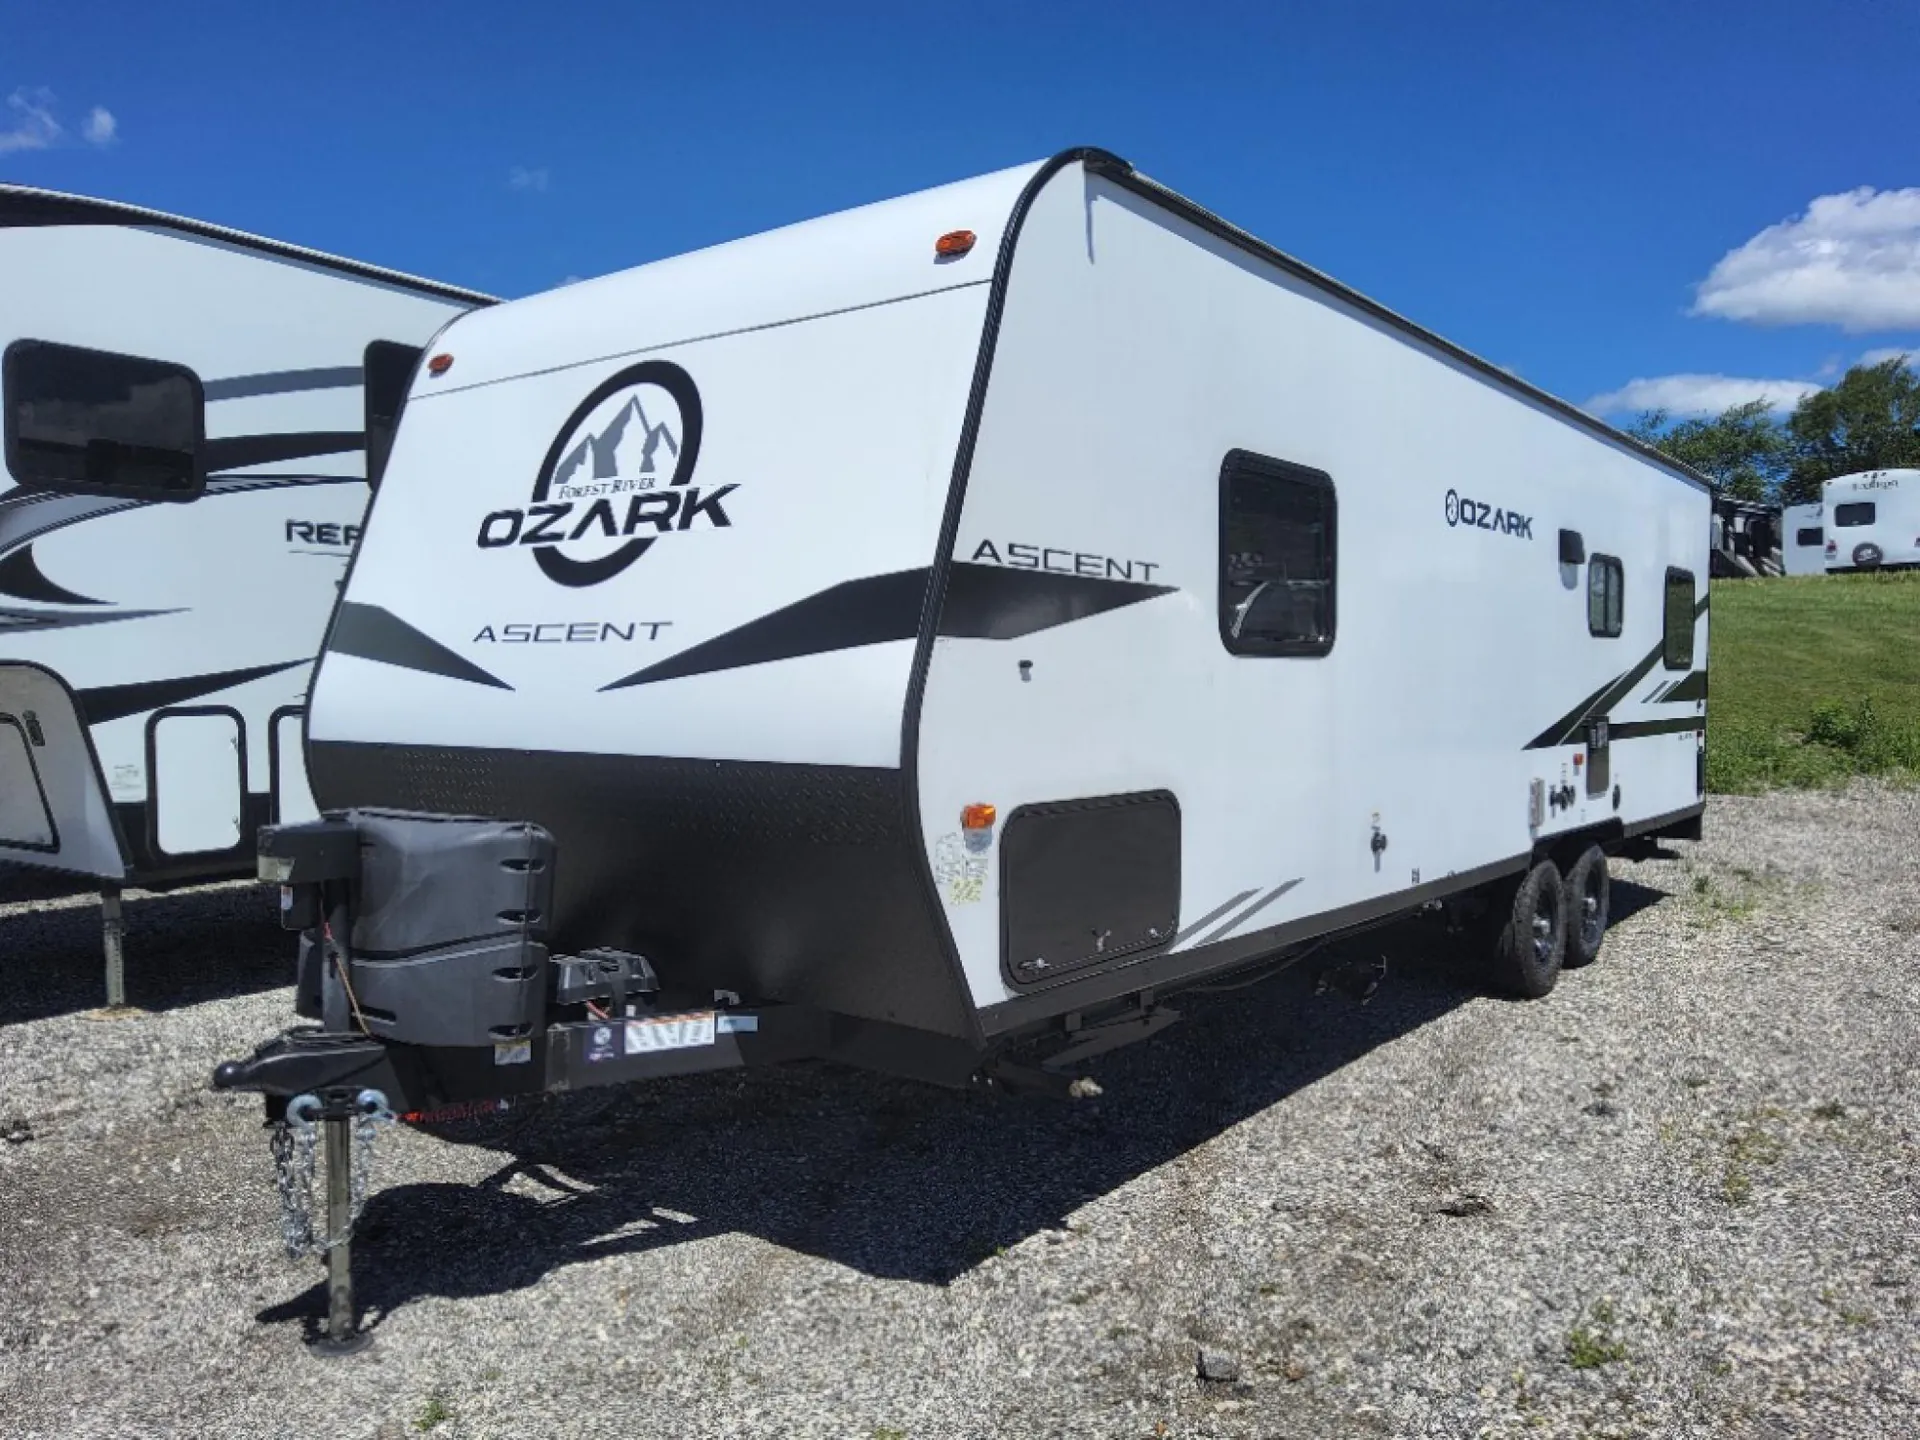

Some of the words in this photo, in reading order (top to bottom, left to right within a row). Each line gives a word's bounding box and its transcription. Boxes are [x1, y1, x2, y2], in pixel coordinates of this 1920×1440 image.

[558, 484, 610, 500] FOREST
[611, 478, 655, 494] RIVER
[477, 484, 741, 549] OZARK
[1461, 498, 1533, 541] OZARK
[971, 539, 1158, 582] ASCENT
[473, 621, 673, 642] ASCENT
